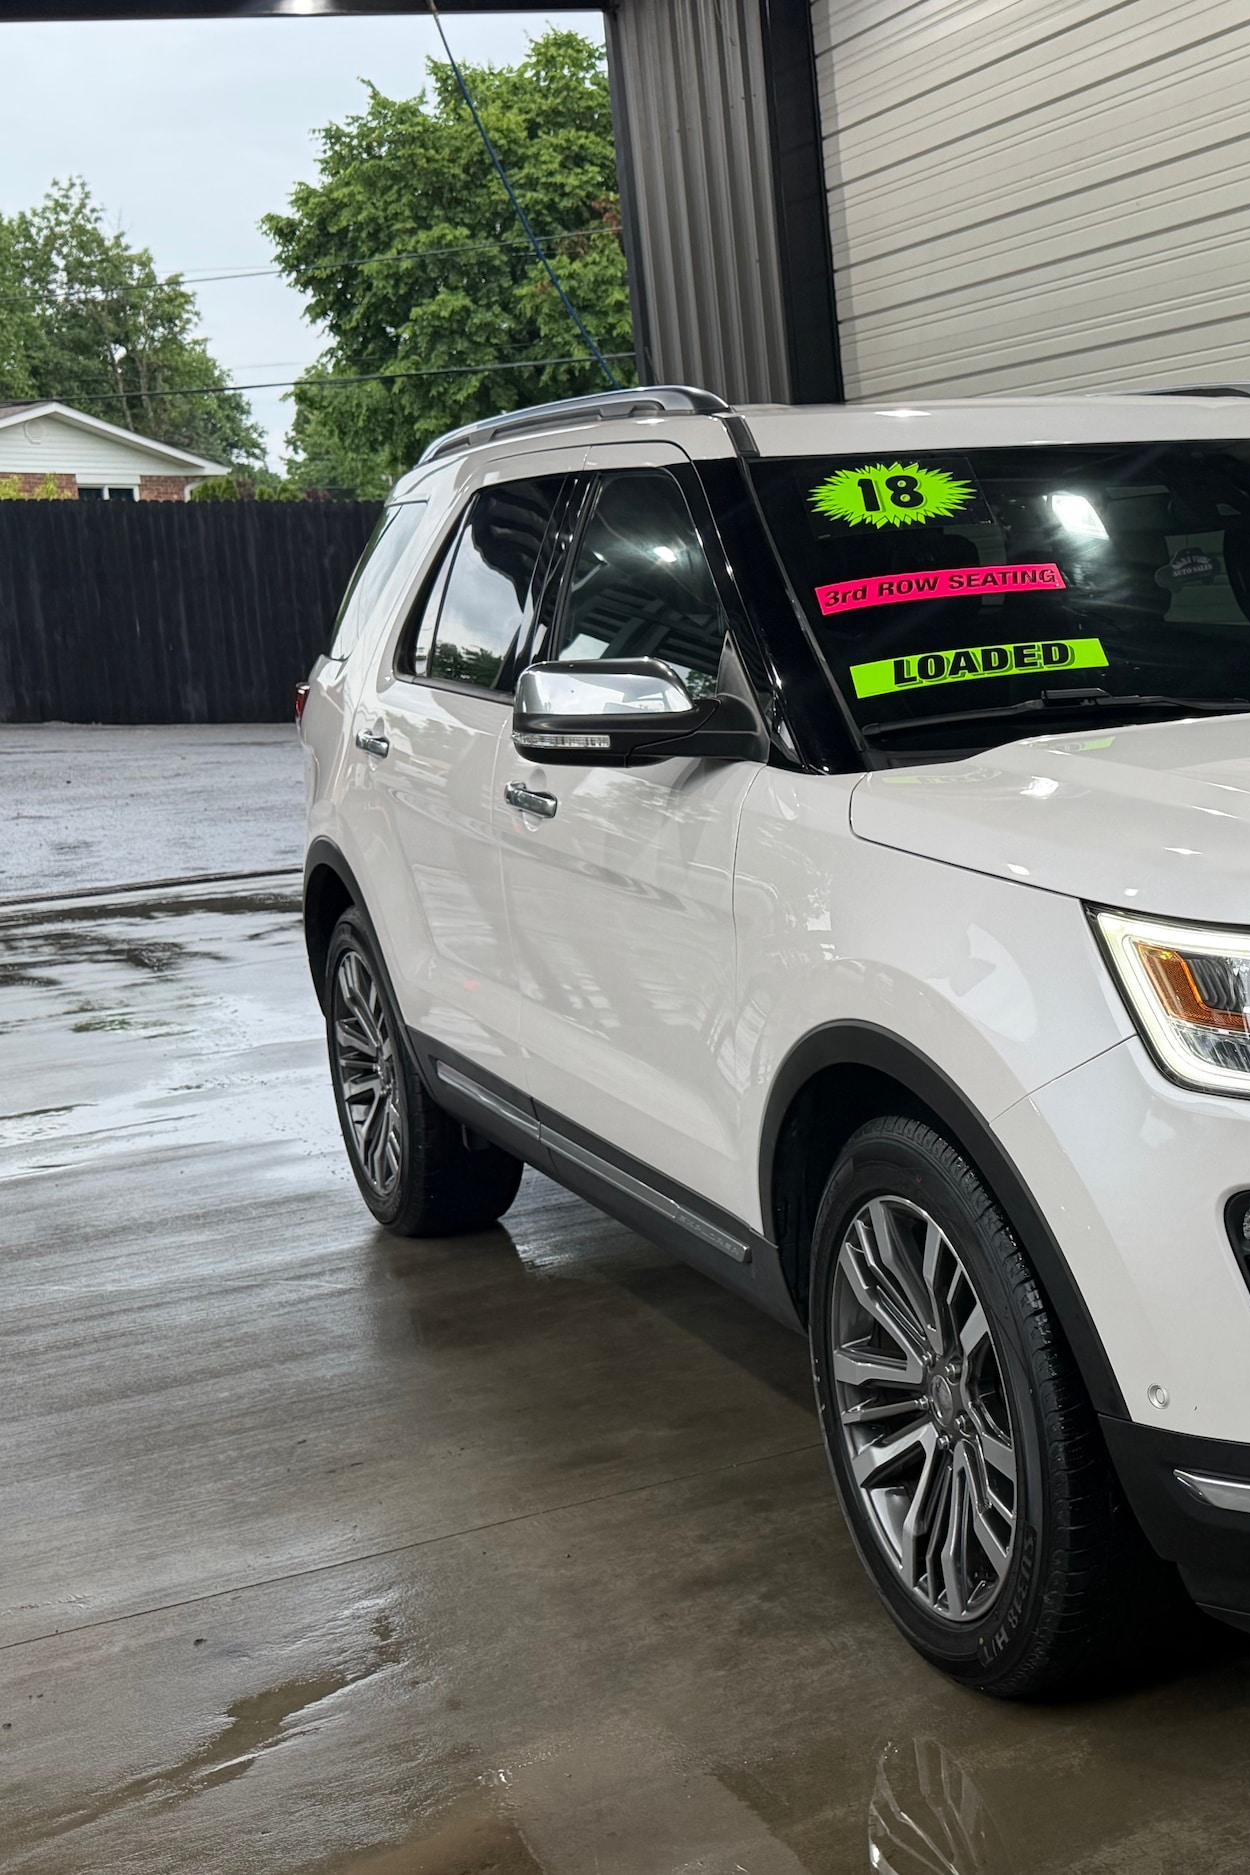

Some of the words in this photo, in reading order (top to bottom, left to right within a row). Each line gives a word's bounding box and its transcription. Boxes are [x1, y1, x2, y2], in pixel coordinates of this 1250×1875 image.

[857, 474, 928, 513] 18
[824, 585, 867, 608] 3rd
[877, 576, 940, 597] ROW
[948, 567, 1058, 589] SEATING
[893, 641, 1075, 688] LOADED
